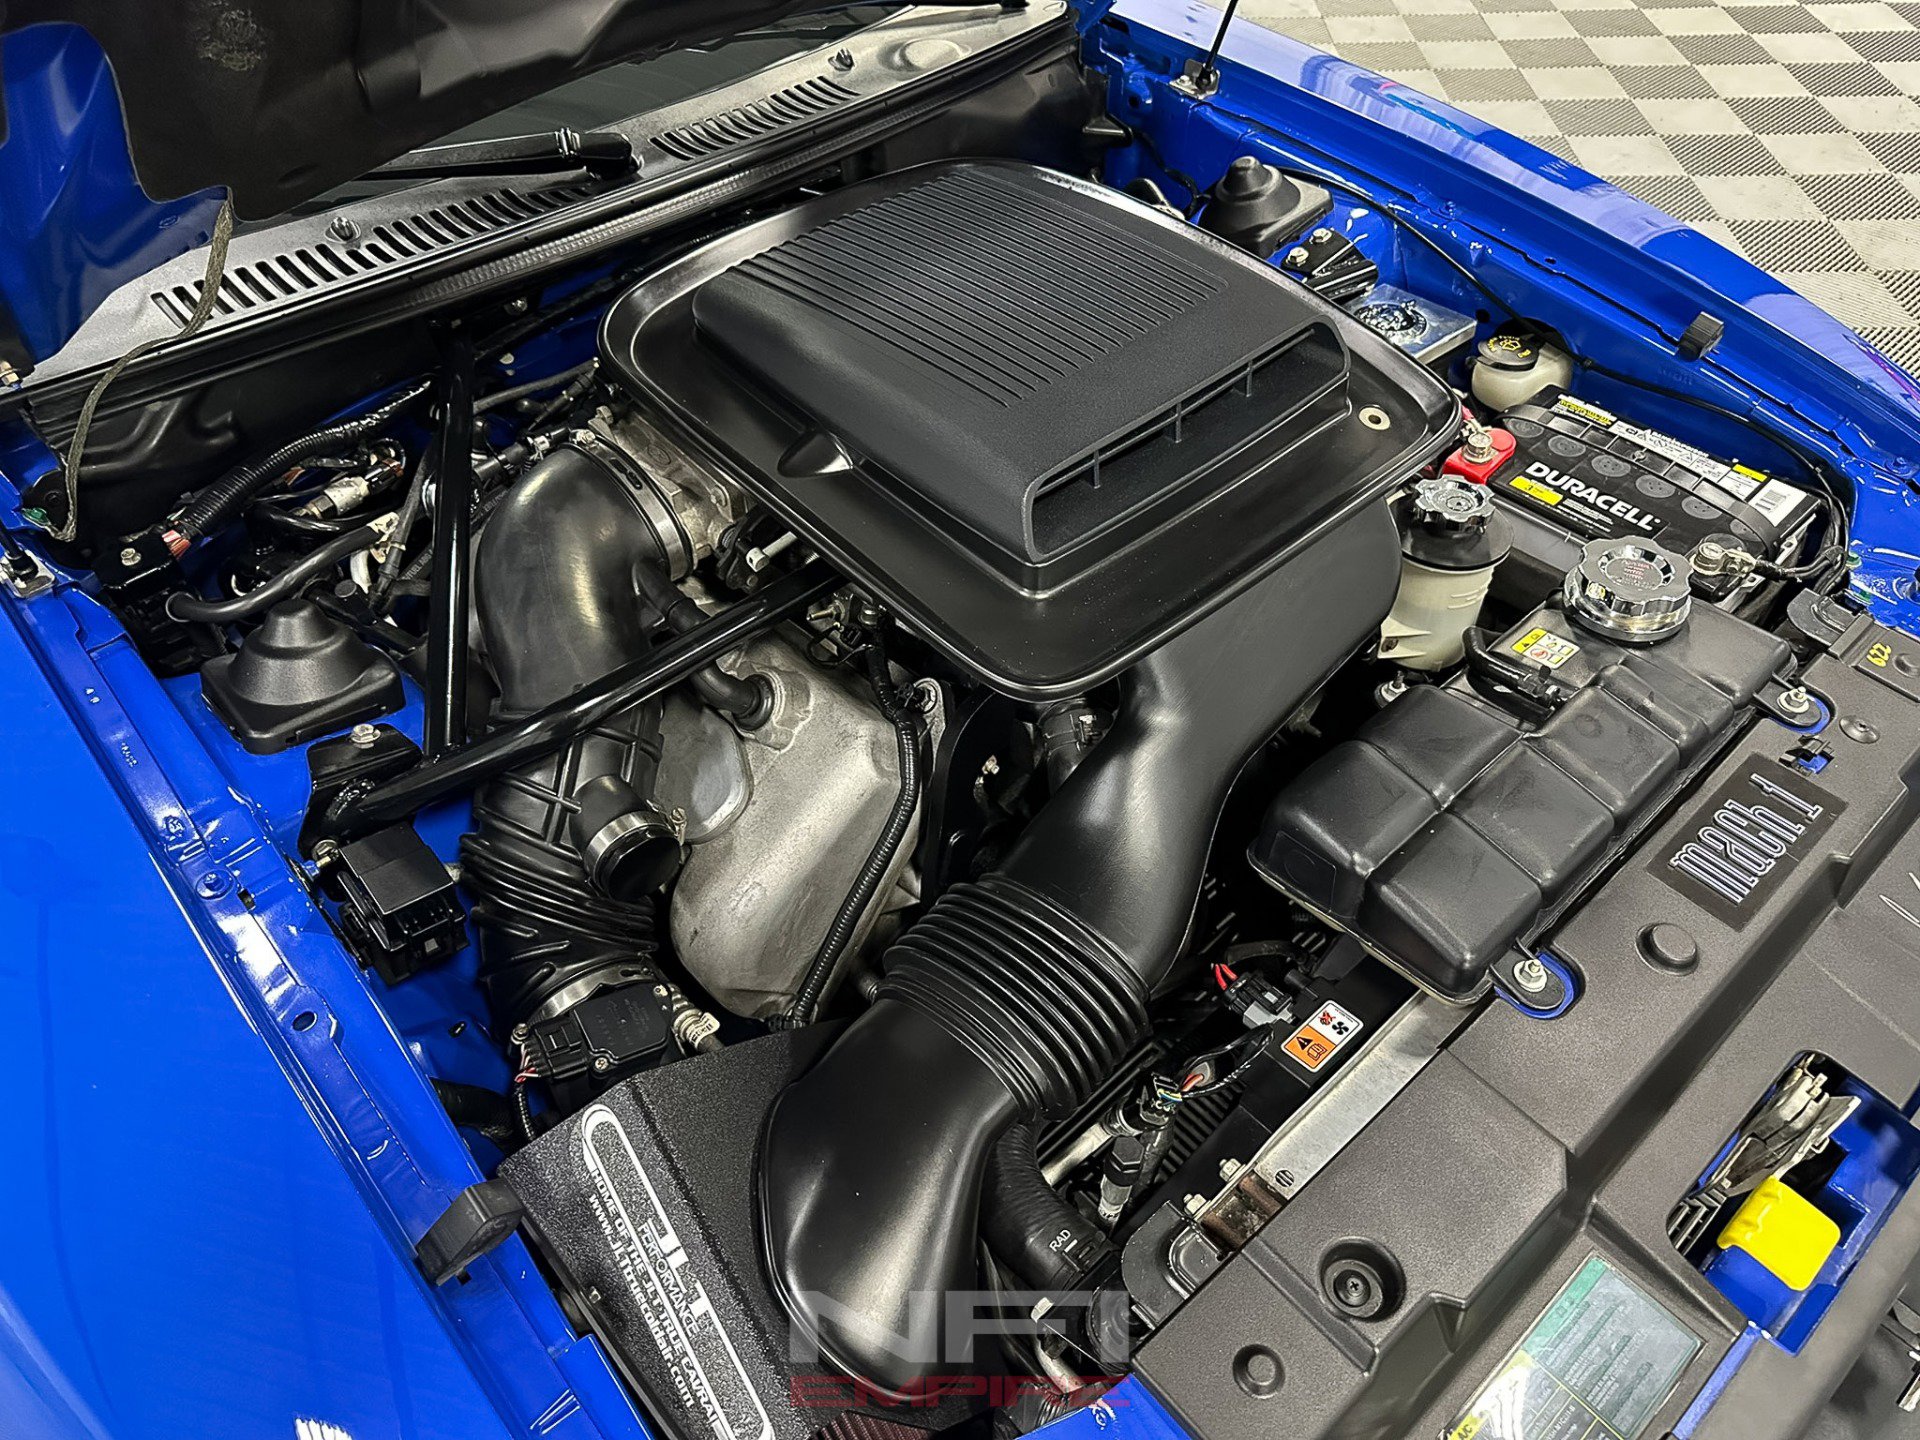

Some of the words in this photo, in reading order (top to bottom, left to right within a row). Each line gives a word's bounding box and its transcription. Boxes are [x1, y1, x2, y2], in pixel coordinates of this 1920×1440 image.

[1525, 461, 1655, 531] DURACELL
[589, 1169, 619, 1216] HOME
[613, 1217, 630, 1240] OF
[624, 1241, 647, 1275] THE
[641, 1276, 663, 1307] JLT
[657, 1308, 686, 1355] TRUE
[637, 1222, 698, 1335] PERFORMANCE
[647, 1216, 708, 1321] JLT
[1049, 1229, 1071, 1252] RAD
